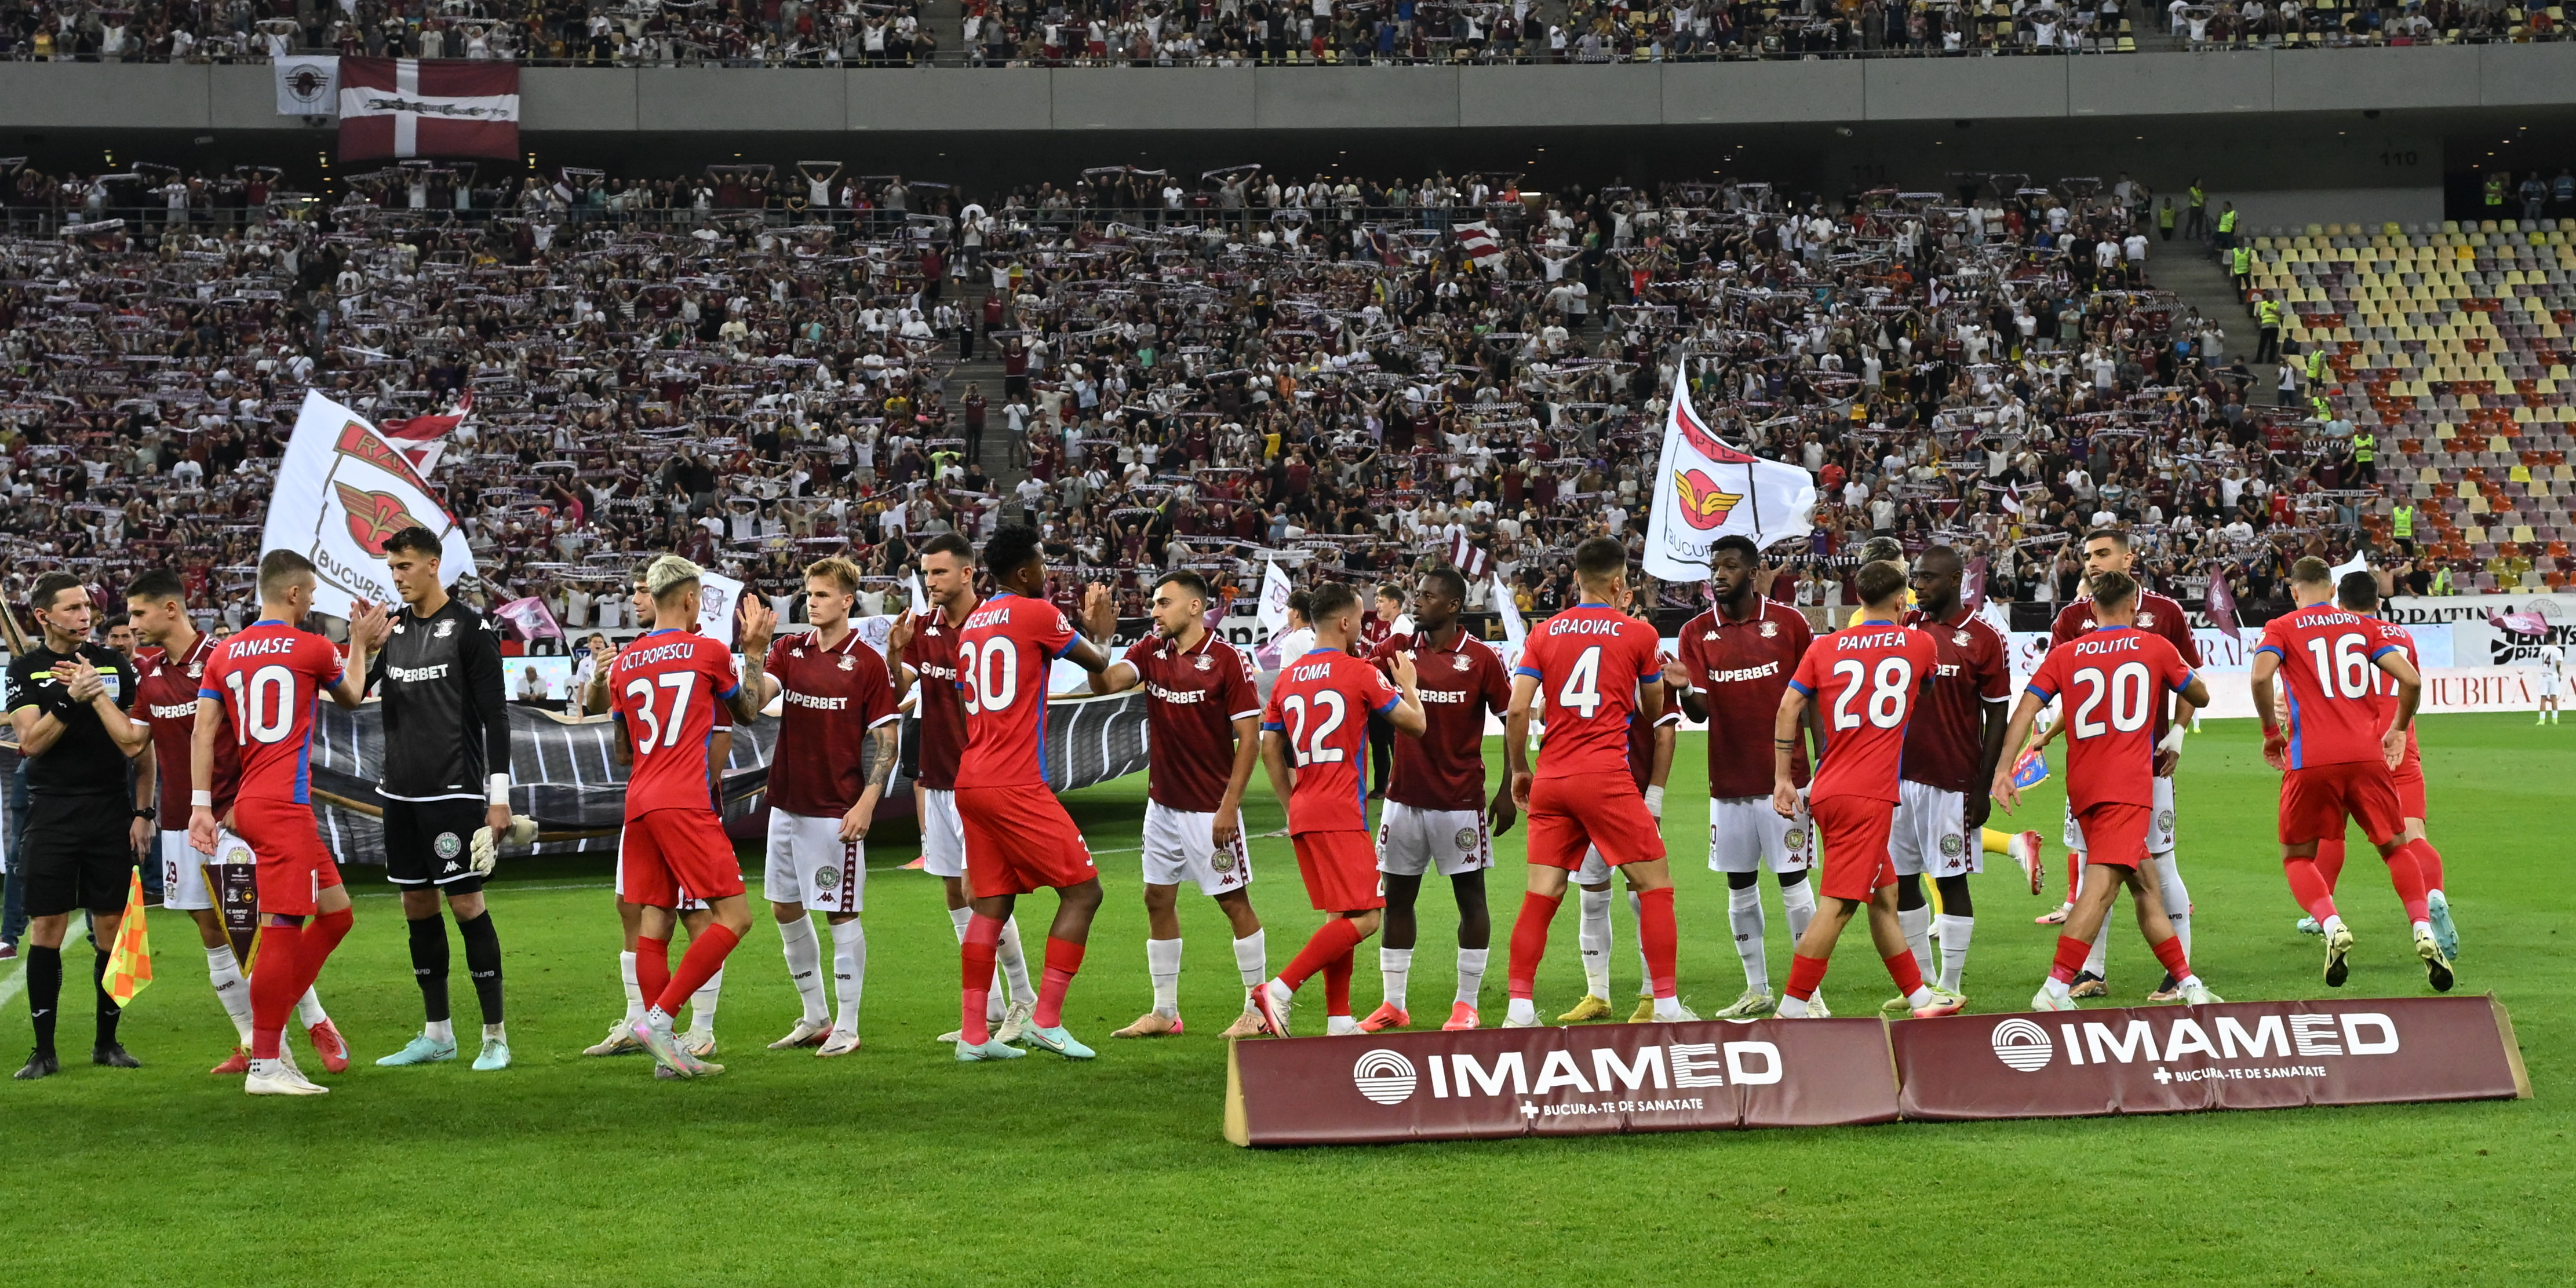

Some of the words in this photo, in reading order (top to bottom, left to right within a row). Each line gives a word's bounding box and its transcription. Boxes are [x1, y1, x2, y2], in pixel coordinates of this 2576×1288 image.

[2380, 152, 2417, 166] 110
[1549, 618, 1623, 636] GRAOVAC
[2296, 614, 2360, 629] LIXANDRU
[2378, 625, 2406, 638] ESCU
[227, 637, 296, 660] TANASE
[1837, 630, 1906, 652] PANTEA
[2074, 636, 2141, 657] POLITIC
[621, 643, 694, 672] OCT.POPESCU
[2307, 632, 2370, 700] 16
[2541, 652, 2551, 665] 14
[920, 662, 956, 681] SUPER
[959, 634, 1018, 717] 30
[1292, 662, 1331, 683] TOMA
[1559, 645, 1602, 718] 4
[1708, 661, 1779, 683] SUPERBET
[785, 690, 848, 710] UPERBET
[1146, 680, 1206, 705] SUPERBET
[1832, 656, 1912, 732] 28
[2073, 661, 2151, 740] 20
[224, 663, 296, 747] 10
[626, 670, 697, 756] 37
[1283, 688, 1346, 768] 22
[166, 859, 178, 884] 29
[2061, 1012, 2400, 1066] IMAMED
[1427, 1041, 1783, 1099] IMAMED
[2176, 1067, 2243, 1082] BUCURA-TE
[2244, 1067, 2262, 1079] DE
[2264, 1065, 2327, 1080] SANATATE
[1543, 1101, 1616, 1116] BUCURA-TE
[1619, 1100, 1635, 1112] DE
[1637, 1097, 1704, 1112] SANATATE
